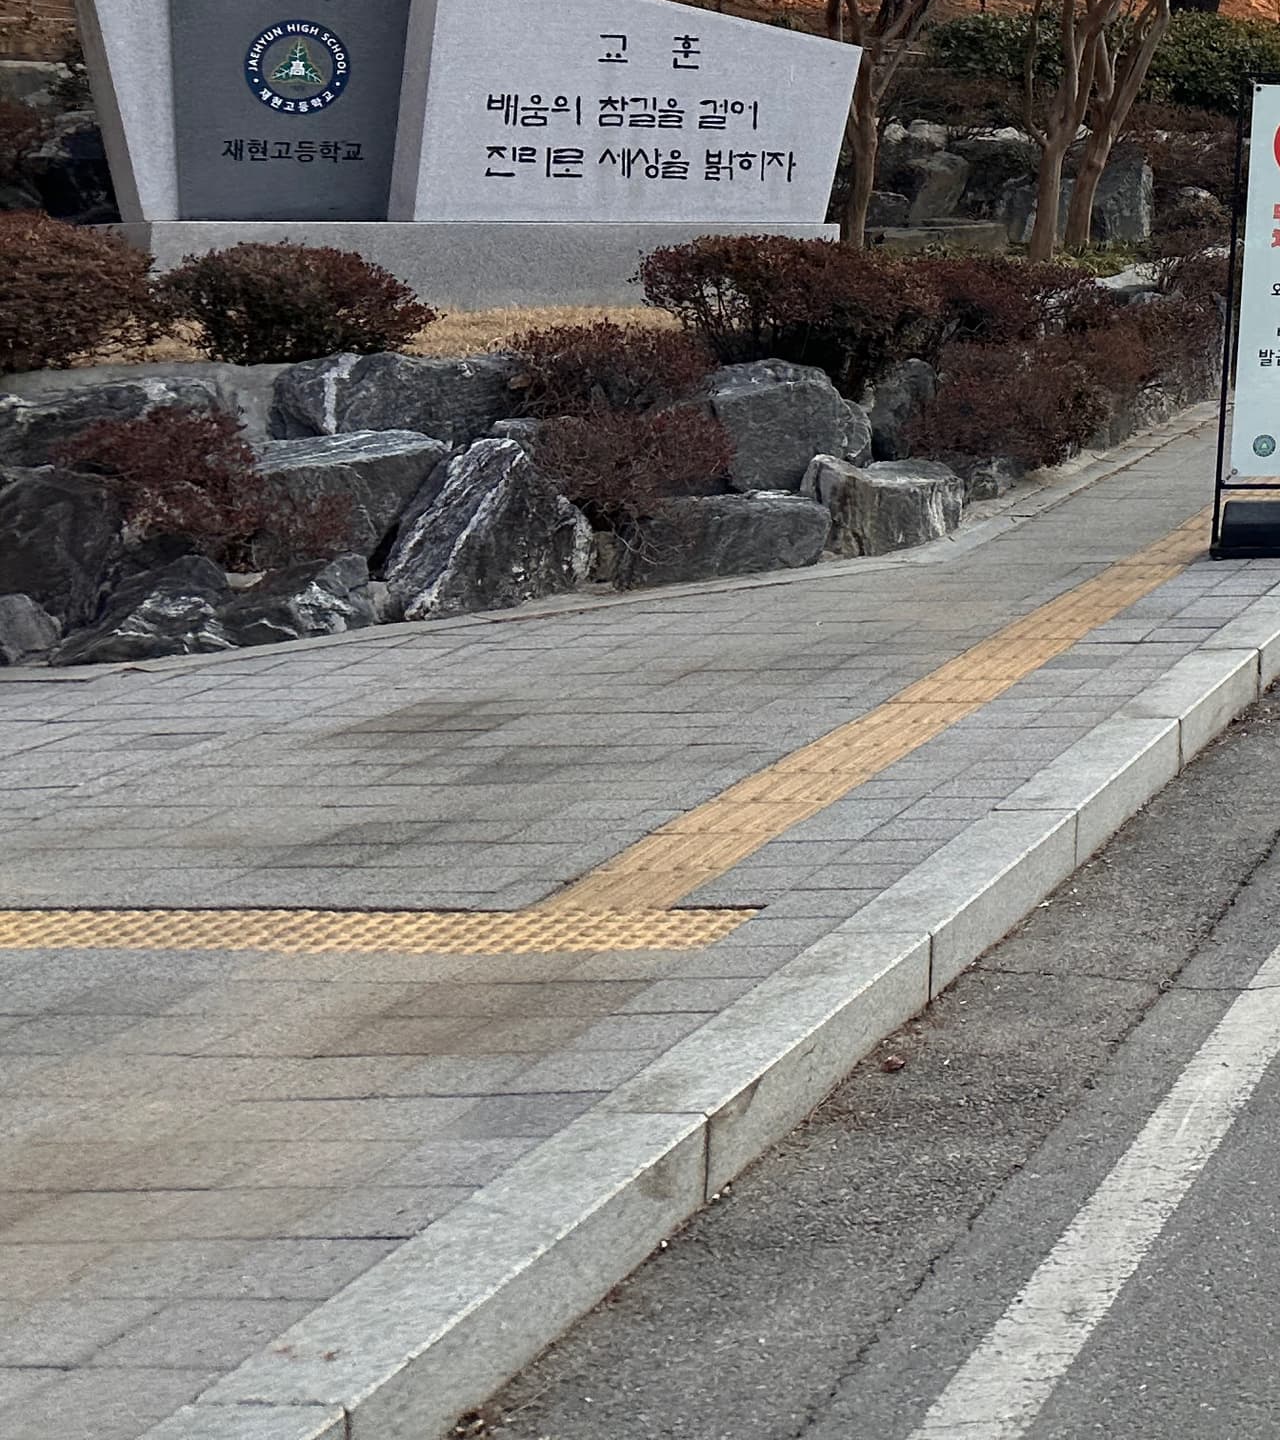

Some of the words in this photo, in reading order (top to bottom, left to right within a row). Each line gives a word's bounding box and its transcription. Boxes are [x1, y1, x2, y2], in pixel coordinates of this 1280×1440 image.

[248, 27, 283, 71] JAEHYUN
[287, 23, 319, 36] HIGH
[321, 32, 347, 75] SCHOOL
[259, 88, 335, 113] 재현고등학교
[486, 93, 581, 127] 배움의
[598, 96, 685, 129] 참길을
[698, 99, 758, 130] 걸어
[221, 138, 365, 164] 재현고등학교
[484, 146, 584, 178] 진리로
[598, 147, 690, 180] 세상을
[704, 149, 797, 183] 밝히자
